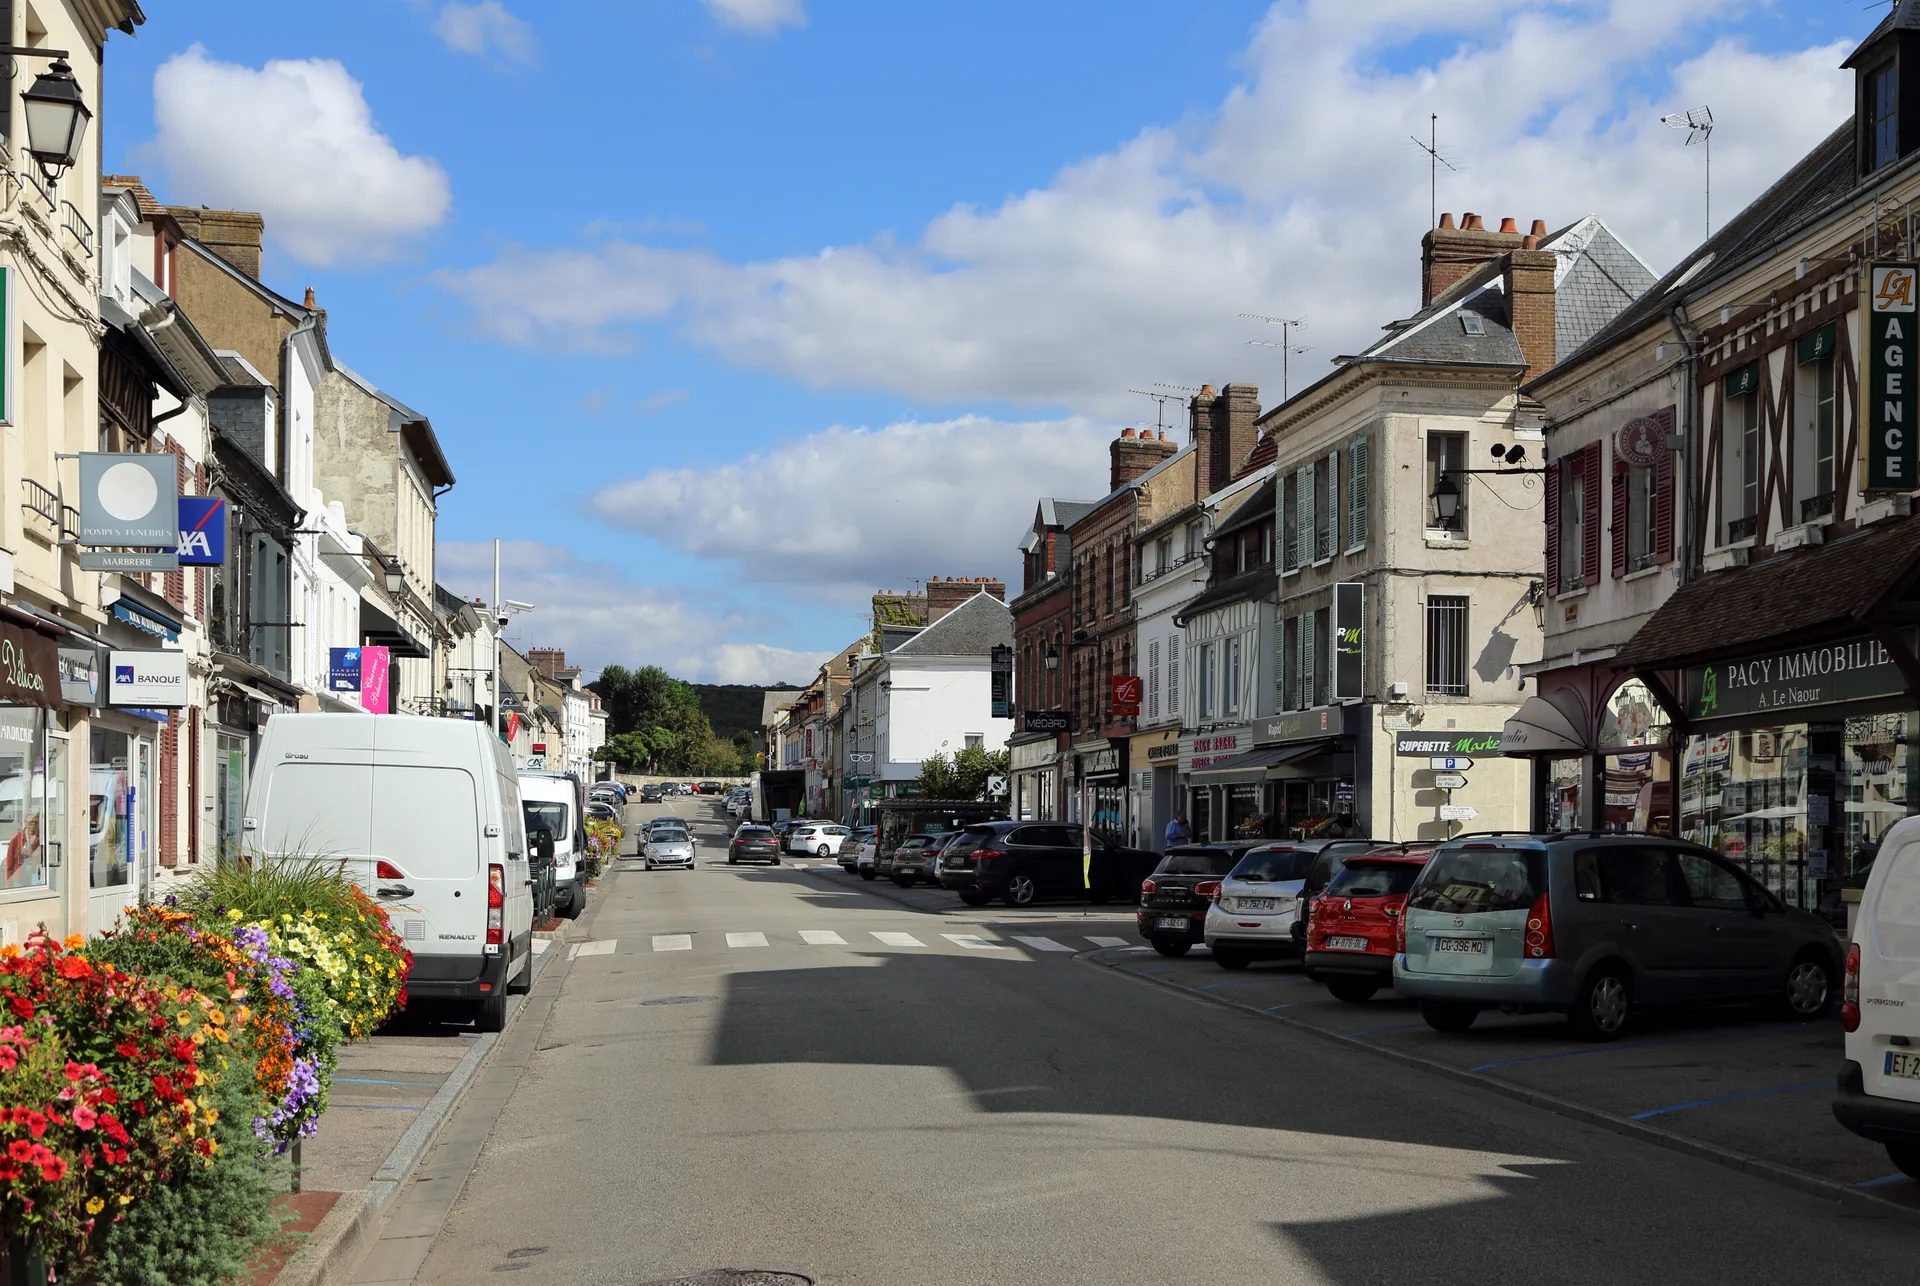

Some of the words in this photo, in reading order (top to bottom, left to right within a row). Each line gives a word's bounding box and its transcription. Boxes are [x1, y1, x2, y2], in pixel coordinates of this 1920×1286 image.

[1884, 317, 1904, 478] AGENCE
[83, 528, 121, 537] POMPES
[125, 528, 172, 537] FUNEBRES
[102, 557, 153, 566] MARBRERIE
[1728, 658, 1773, 689] PACY
[1778, 640, 1895, 681] IMMOBILIE
[137, 675, 181, 684] BANQUE
[1758, 692, 1770, 708] A.
[1772, 689, 1786, 706] Le
[1788, 686, 1821, 703] Naour
[1398, 740, 1451, 752] SUPERETTE
[1866, 998, 1905, 1007] PEUGEOT
